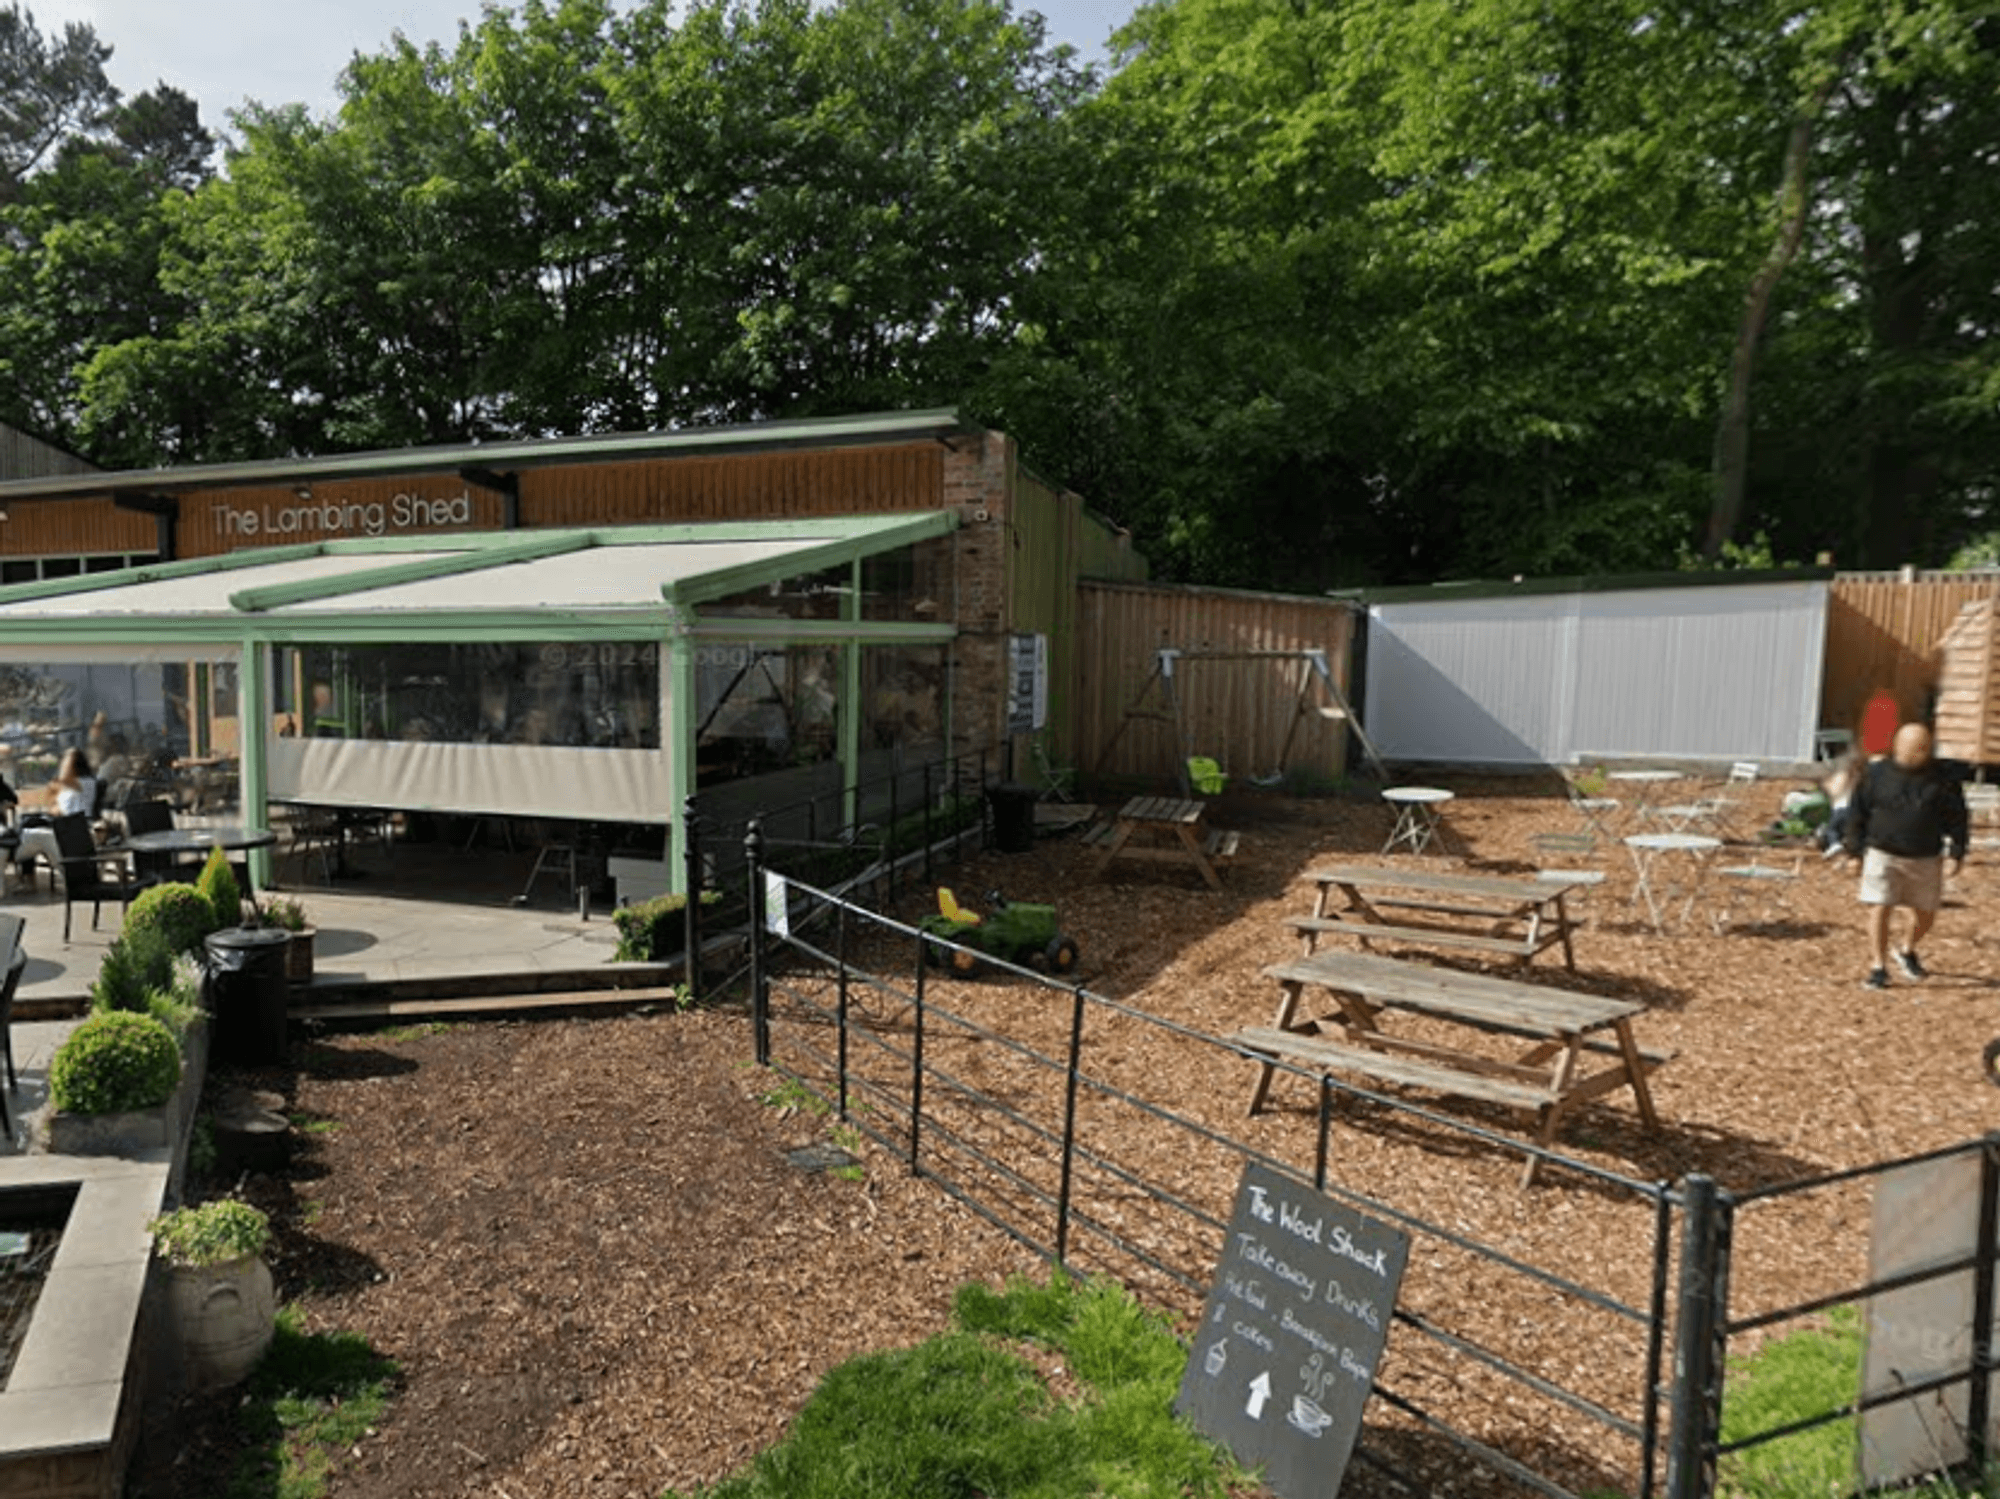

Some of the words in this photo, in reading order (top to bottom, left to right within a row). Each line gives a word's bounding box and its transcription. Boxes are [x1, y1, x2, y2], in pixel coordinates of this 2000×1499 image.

[211, 504, 259, 535] The
[263, 499, 386, 536] Lambing
[391, 489, 472, 527] Shed
[1248, 1186, 1275, 1224] The
[1328, 1226, 1388, 1278] Shack
[1326, 1280, 1380, 1333] Drinks
